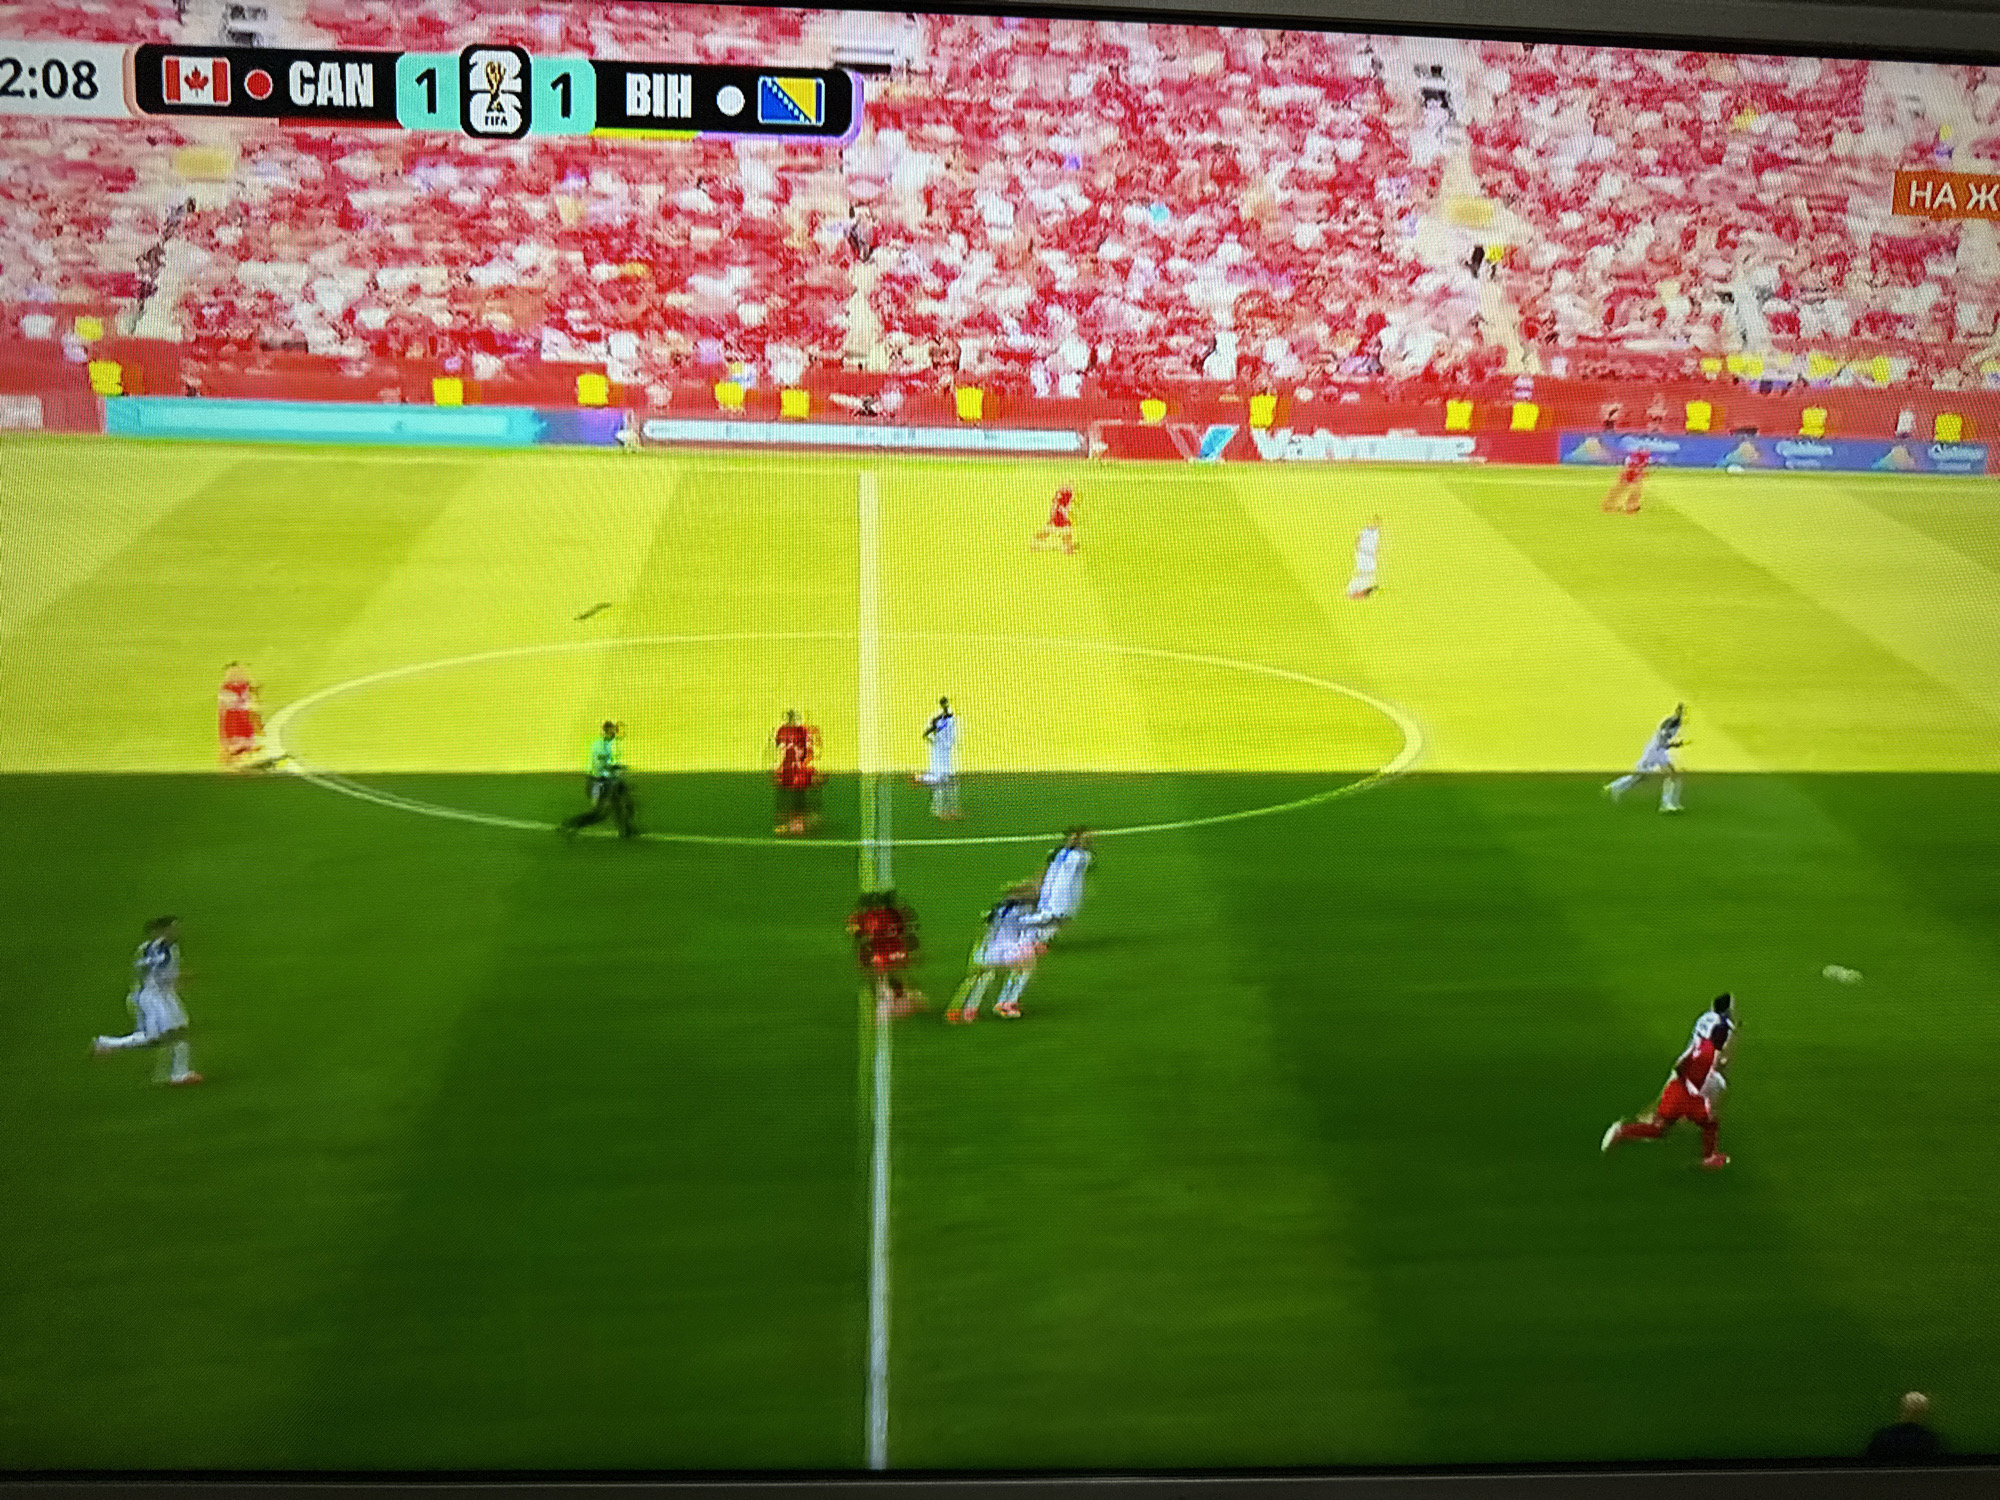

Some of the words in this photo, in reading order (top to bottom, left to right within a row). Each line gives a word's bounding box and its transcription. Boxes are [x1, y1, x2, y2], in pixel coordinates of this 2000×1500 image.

[0, 57, 98, 100] 2:08
[289, 60, 374, 108] CAN
[415, 67, 437, 115] 1
[550, 72, 572, 119] 1
[626, 72, 692, 119] BIH
[484, 115, 508, 127] FIFA
[1909, 180, 1957, 210] НА
[1966, 182, 2000, 212] Ж
